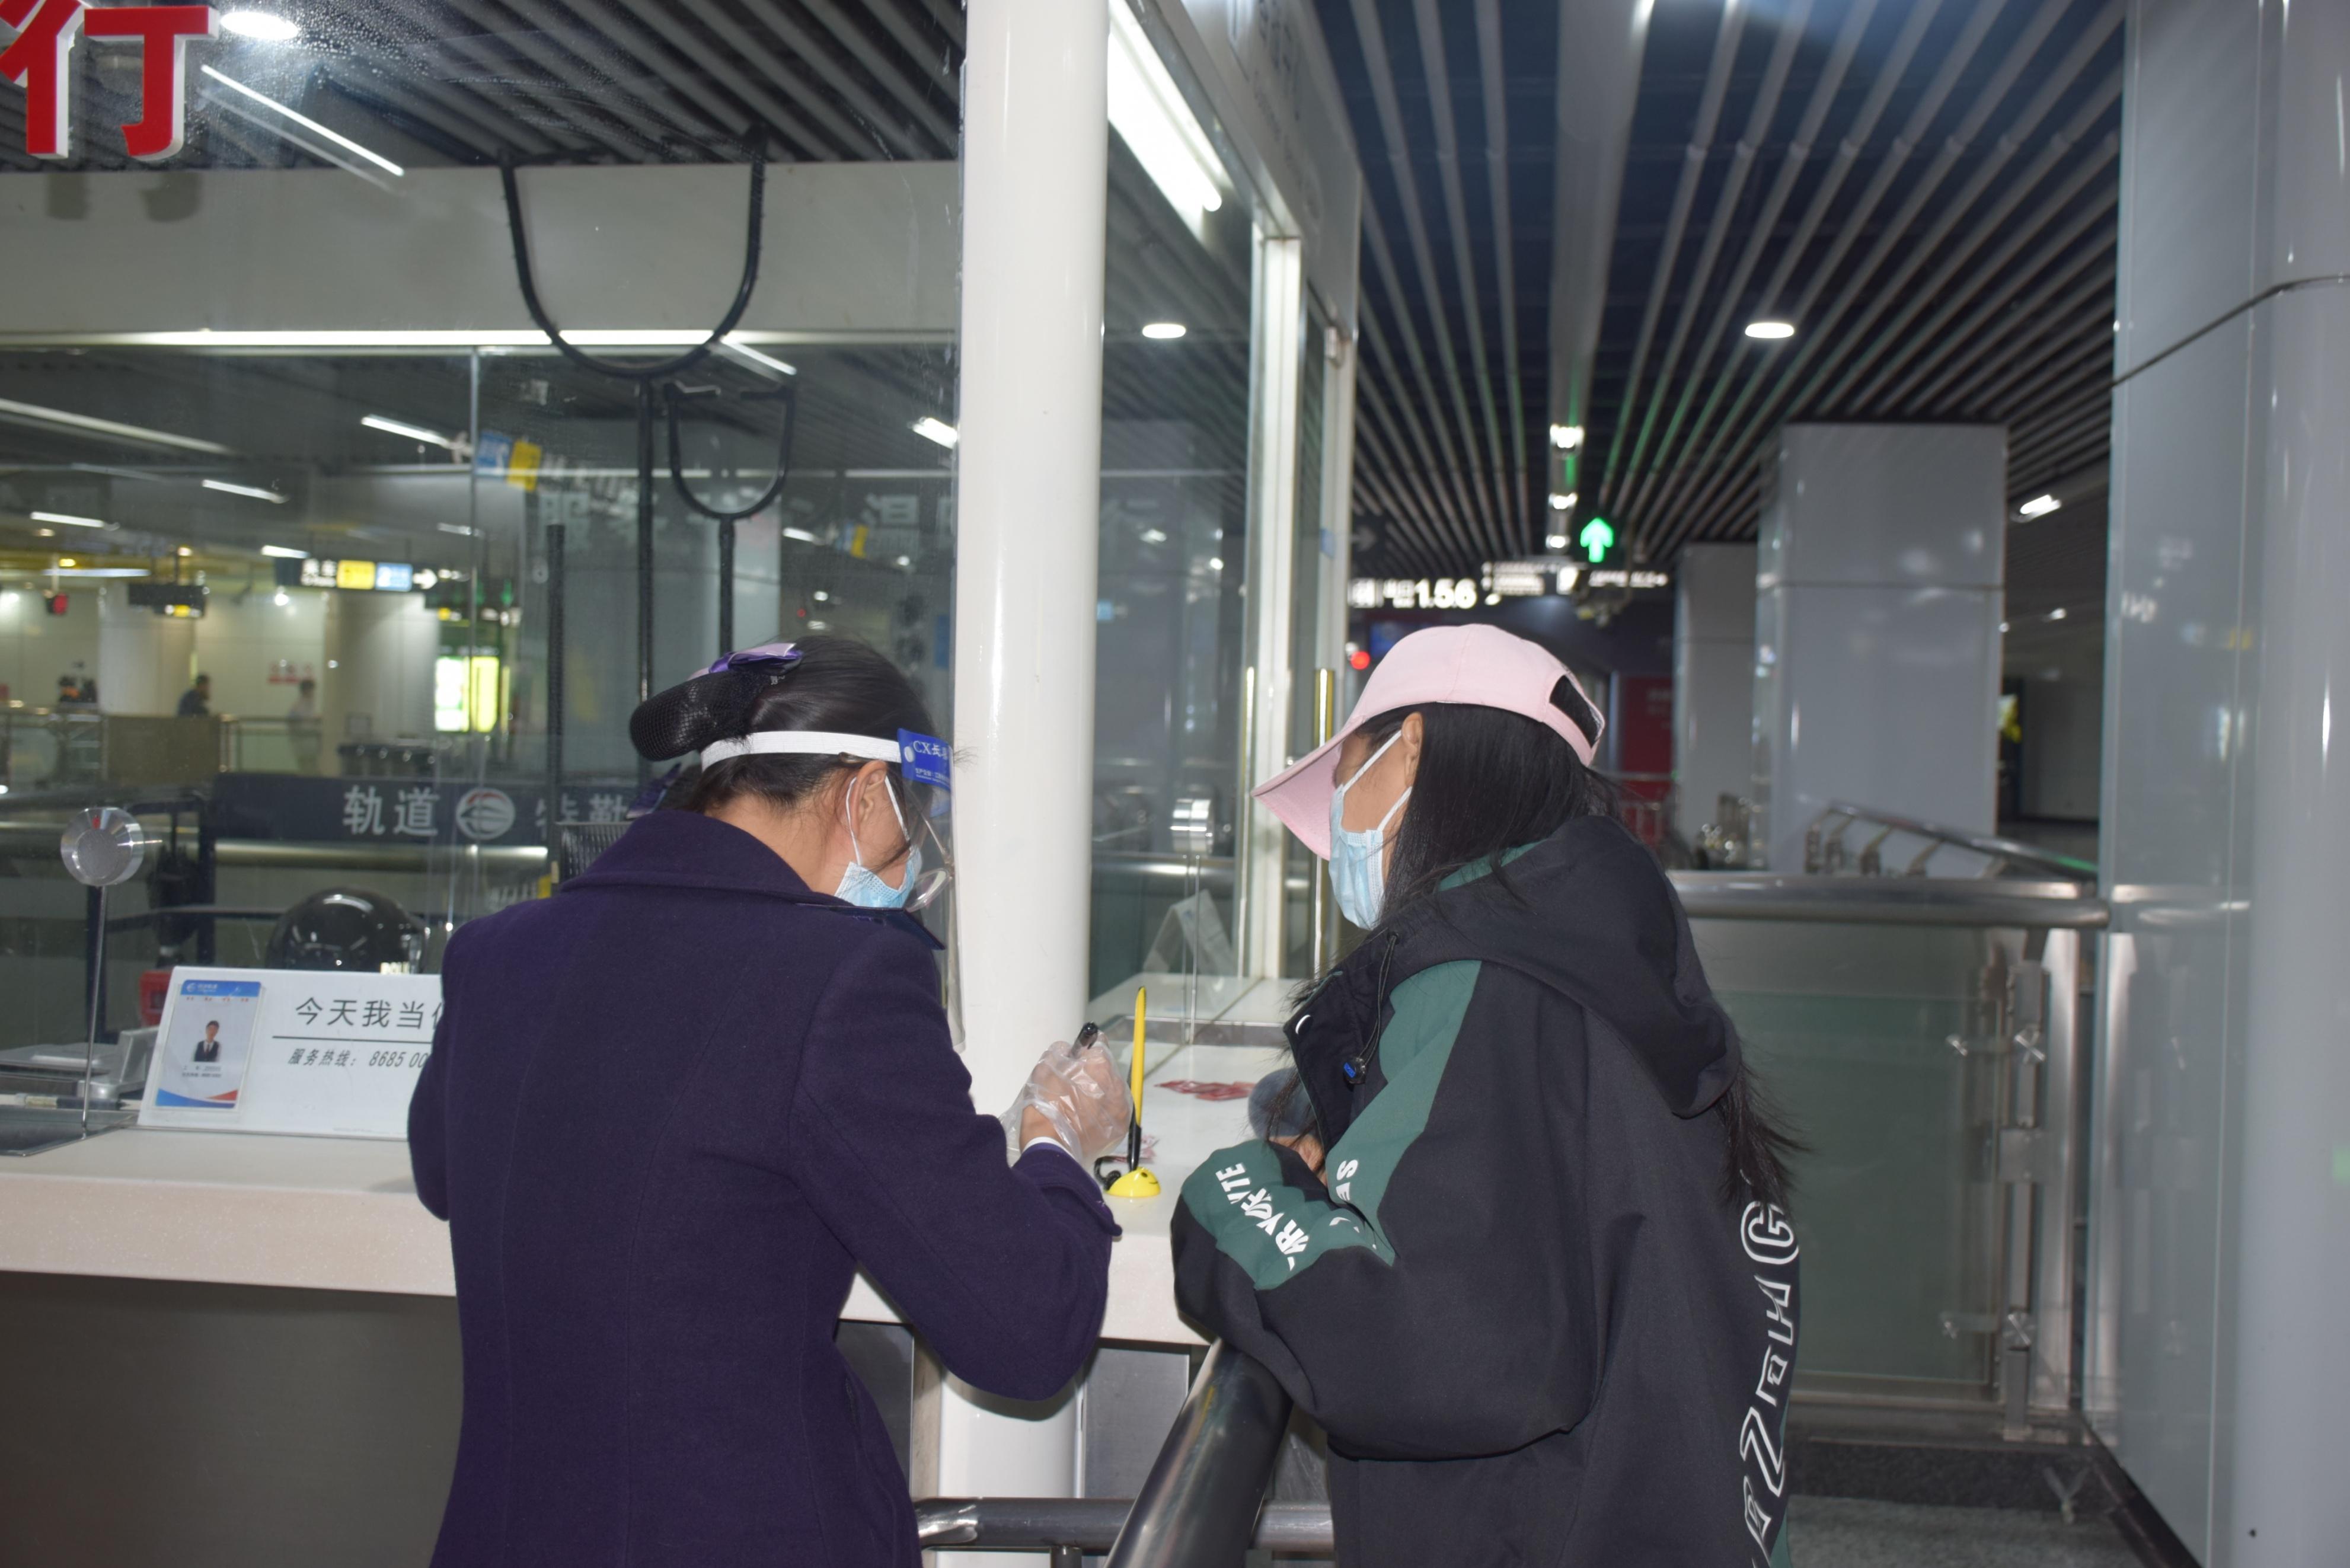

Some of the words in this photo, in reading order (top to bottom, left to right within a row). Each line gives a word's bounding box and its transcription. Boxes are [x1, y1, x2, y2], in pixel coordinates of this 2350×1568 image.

[0, 0, 218, 159] 行
[343, 785, 440, 835] 轨道
[288, 1048, 356, 1067] 服务热线：
[368, 1051, 407, 1068] 8685
